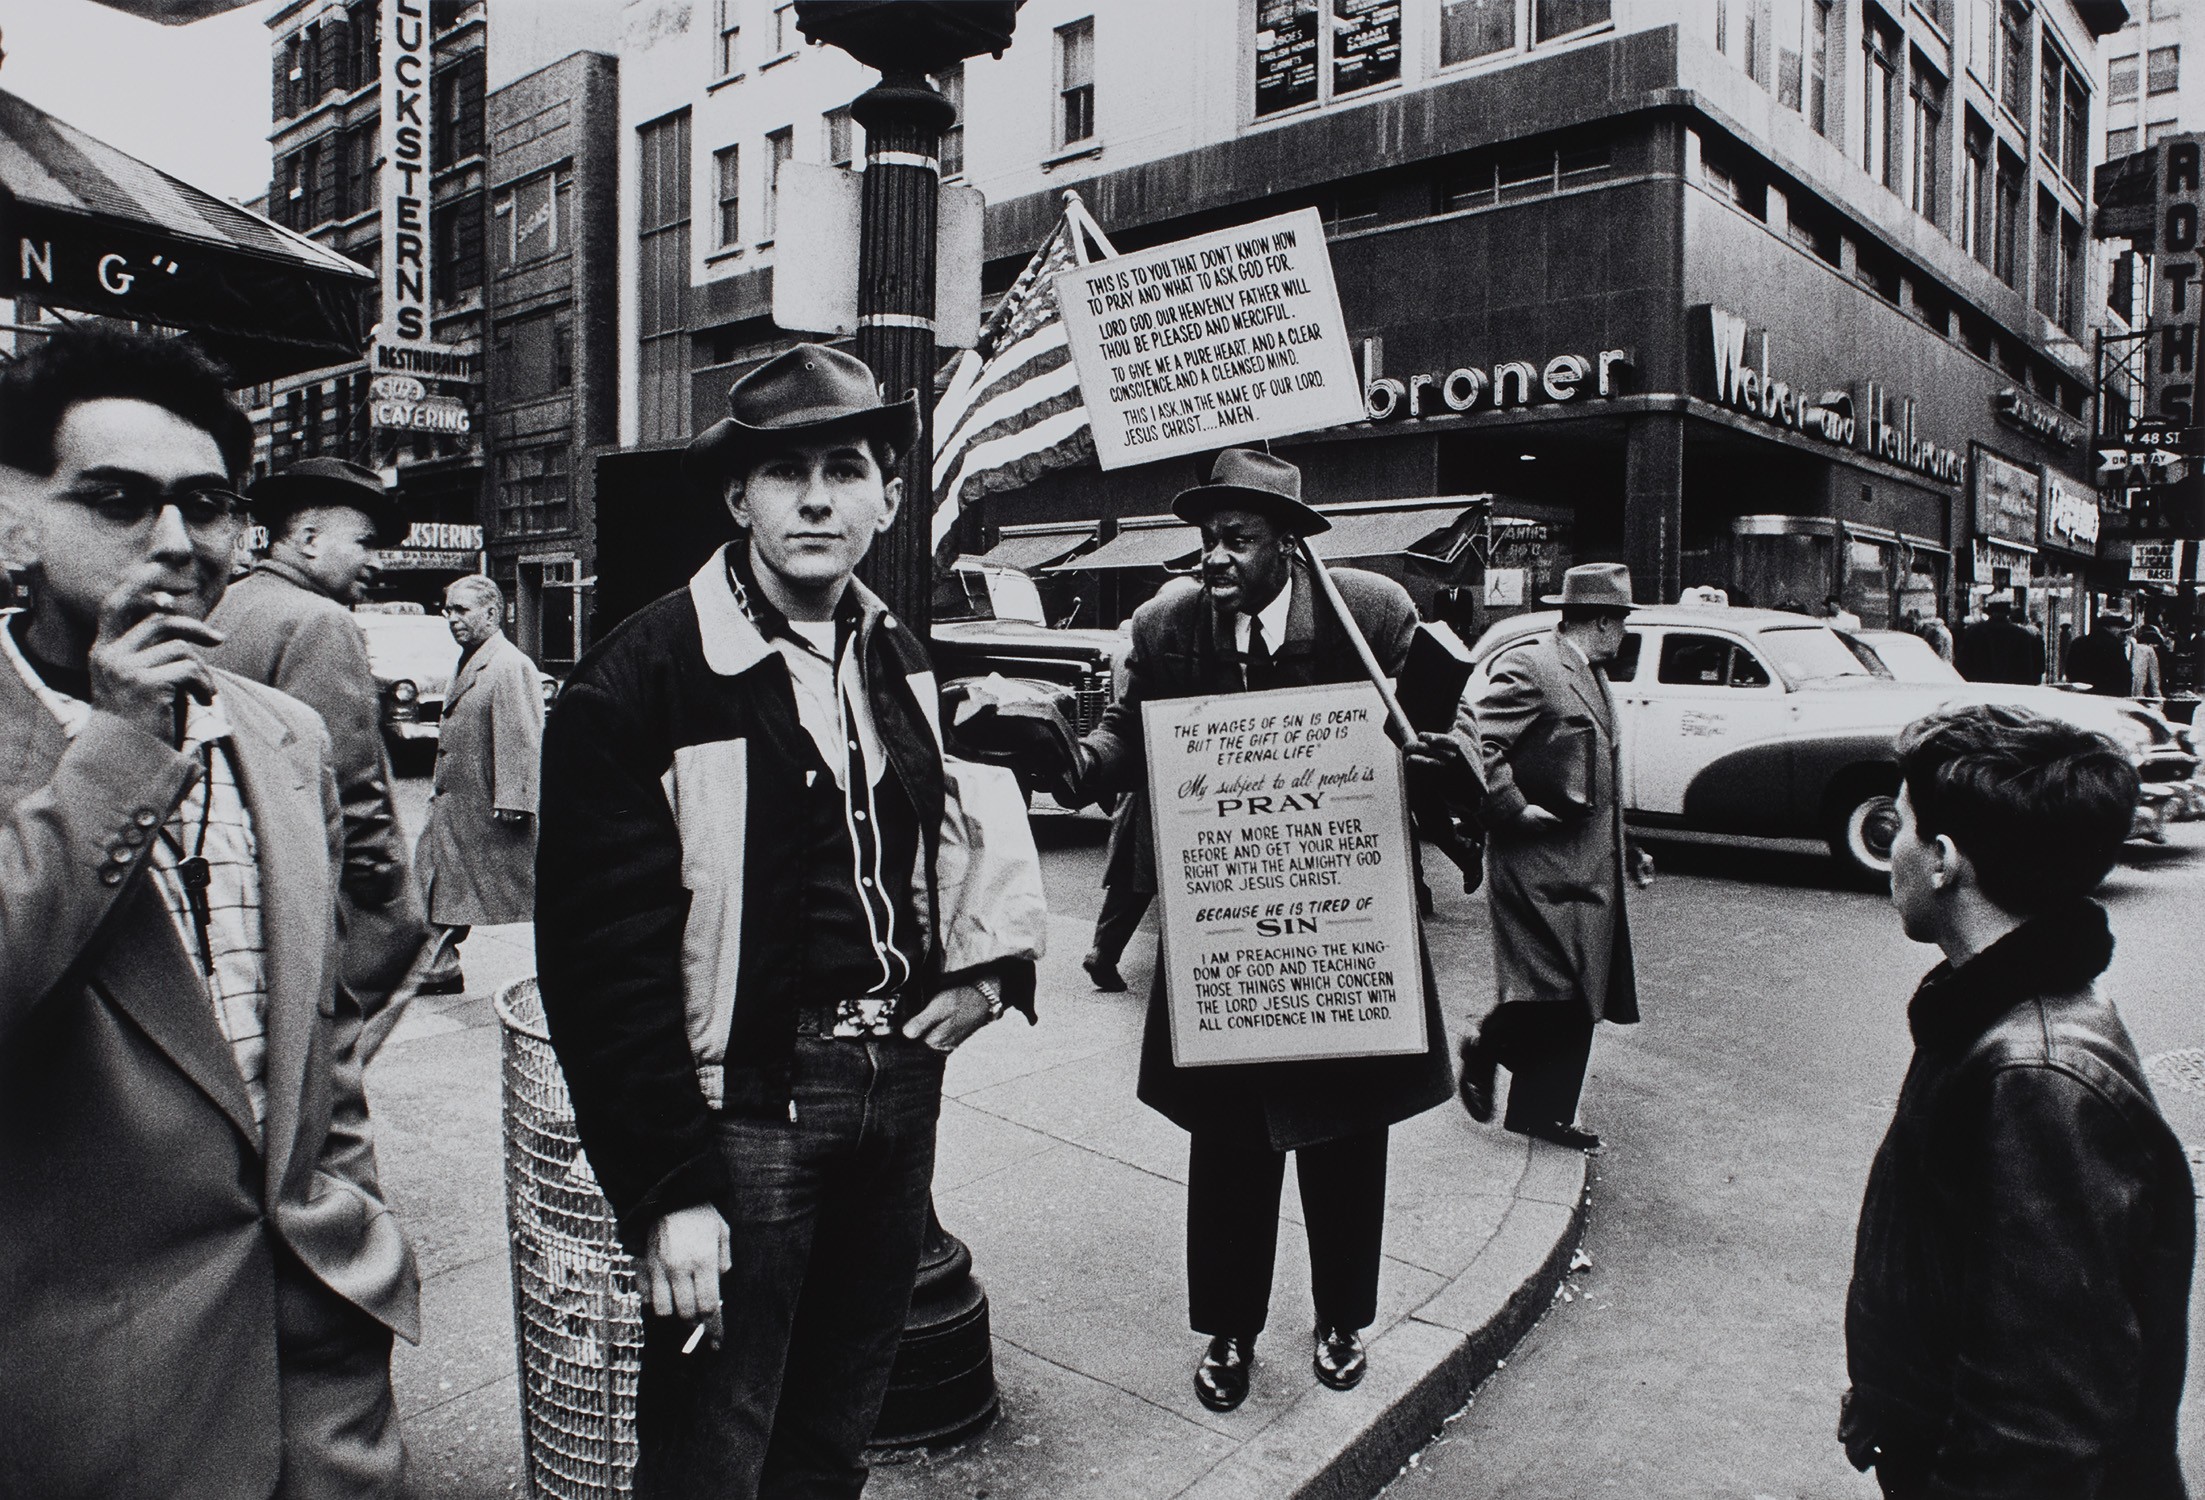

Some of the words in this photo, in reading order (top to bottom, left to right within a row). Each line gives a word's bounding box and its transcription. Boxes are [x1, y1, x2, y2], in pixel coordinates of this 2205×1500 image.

[1085, 274, 1115, 297] THIS
[1115, 271, 1129, 290] IS
[1129, 266, 1147, 286] TO
[1145, 260, 1172, 281] YOU
[1169, 253, 1198, 276] THAT
[1199, 245, 1233, 269] DON'T
[1234, 235, 1270, 260] KNOW
[1271, 229, 1296, 251] HOW
[1086, 297, 1103, 316] TO
[1104, 289, 1134, 312] PRAY
[1137, 283, 1161, 305] AND
[1161, 275, 1194, 298] WHAT
[1195, 271, 1211, 290] TO
[1213, 264, 1238, 287] ASK
[1237, 259, 1263, 281] GOD
[1264, 252, 1294, 274] FOR.
[1098, 318, 1127, 340] LORD
[1155, 306, 1178, 326] OUR
[1177, 291, 1235, 321] HEAVENLY
[1238, 282, 1281, 307] FATHER
[1280, 277, 1311, 297] WILL
[1098, 338, 1131, 360] THOU
[1132, 333, 1150, 353] BE
[1150, 322, 1202, 349] PLEASED
[1204, 315, 1230, 336] AND
[1230, 302, 1295, 330] MERCIFUL.
[1110, 365, 1125, 383] TO
[1127, 359, 1153, 379] GIVE
[1154, 355, 1172, 374] ME
[1173, 353, 1183, 370] A
[1182, 345, 1213, 367] PURE
[1251, 332, 1275, 353] AND
[1277, 330, 1287, 348] A
[1287, 322, 1322, 345] CLEAR
[1174, 369, 1198, 389] AND
[1200, 367, 1210, 384] A
[1211, 354, 1265, 381] CLEANSED
[1265, 348, 1299, 370] MIND.
[1122, 406, 1148, 426] THIS
[1149, 405, 1156, 421] I
[1179, 397, 1194, 414] IN
[1193, 392, 1216, 411] THE
[1215, 384, 1250, 406] NAME
[1251, 381, 1266, 399] OF
[1269, 376, 1293, 396] OUR
[1711, 304, 1808, 429] Weber
[1867, 381, 1967, 485] Heilbroner
[377, 402, 470, 432] CATERING
[1123, 424, 1158, 446] JESUS
[2139, 432, 2160, 445] 48
[1174, 723, 1199, 738] THE
[1207, 717, 1255, 735] WAGES
[1260, 716, 1276, 729] OF
[1282, 714, 1303, 728] SIN
[1309, 712, 1321, 725] IS
[1186, 738, 1211, 753] BUT
[1219, 734, 1244, 750] THE
[1249, 731, 1278, 746] GIFT
[1283, 729, 1300, 743] OF
[1305, 727, 1331, 742] GOD
[1335, 725, 1348, 739] IS
[1216, 748, 1279, 765] ETERNAL
[1177, 773, 1208, 801] My
[1213, 774, 1265, 797] subject
[1272, 772, 1285, 789] to
[1290, 768, 1314, 788] all
[1317, 764, 1359, 790] people
[1360, 762, 1374, 781] is
[1216, 790, 1325, 817] PRAY
[1197, 829, 1232, 845] PRAY
[1240, 824, 1279, 842] MORE
[1284, 821, 1322, 838] THAN
[1327, 817, 1362, 835] EVER
[1181, 845, 1228, 864] BEFORE
[1233, 843, 1260, 859] AND
[1265, 840, 1290, 856] GET
[1298, 837, 1334, 854] YOUR
[1337, 833, 1380, 851] HEART
[1183, 863, 1219, 880] RIGHT
[1224, 860, 1257, 876] WITH
[1261, 857, 1285, 873] THE
[1288, 851, 1351, 872] ALMIGHTY
[1355, 849, 1381, 866] GOD
[1186, 877, 1234, 895] SAVIOR
[1238, 874, 1284, 891] JESUS
[1289, 870, 1341, 887] CHRIST.
[1195, 904, 1259, 922] BECAUSE
[1264, 902, 1284, 916] HE
[1288, 901, 1303, 915] IS
[1308, 897, 1350, 914] TIRED
[1355, 896, 1373, 911] OF
[1255, 915, 1317, 937] SIN
[1201, 953, 1206, 965] I
[1209, 950, 1229, 964] AM
[1235, 945, 1317, 962] PREACHING
[1321, 942, 1347, 957] THE
[1351, 940, 1390, 955] KING-
[1192, 965, 1220, 981] DOM
[1225, 964, 1241, 979] OF
[1245, 962, 1274, 977] GOD
[1279, 960, 1306, 975] AND
[1310, 956, 1376, 973] TEACHING
[1194, 981, 1233, 998] THOSE
[1237, 977, 1286, 995] THINGS
[1289, 975, 1331, 991] WHICH
[1336, 970, 1394, 989] CONCERN
[1195, 999, 1220, 1015] THE
[1224, 997, 1257, 1013] LORD
[1262, 993, 1310, 1011] JESUS
[1315, 990, 1362, 1007] CHRIST
[1366, 988, 1396, 1003] WITH
[1198, 1017, 1222, 1031] ALL
[1226, 1011, 1306, 1029] CONFIDENCE
[1310, 1010, 1326, 1023] IN
[1330, 1007, 1355, 1022] THE
